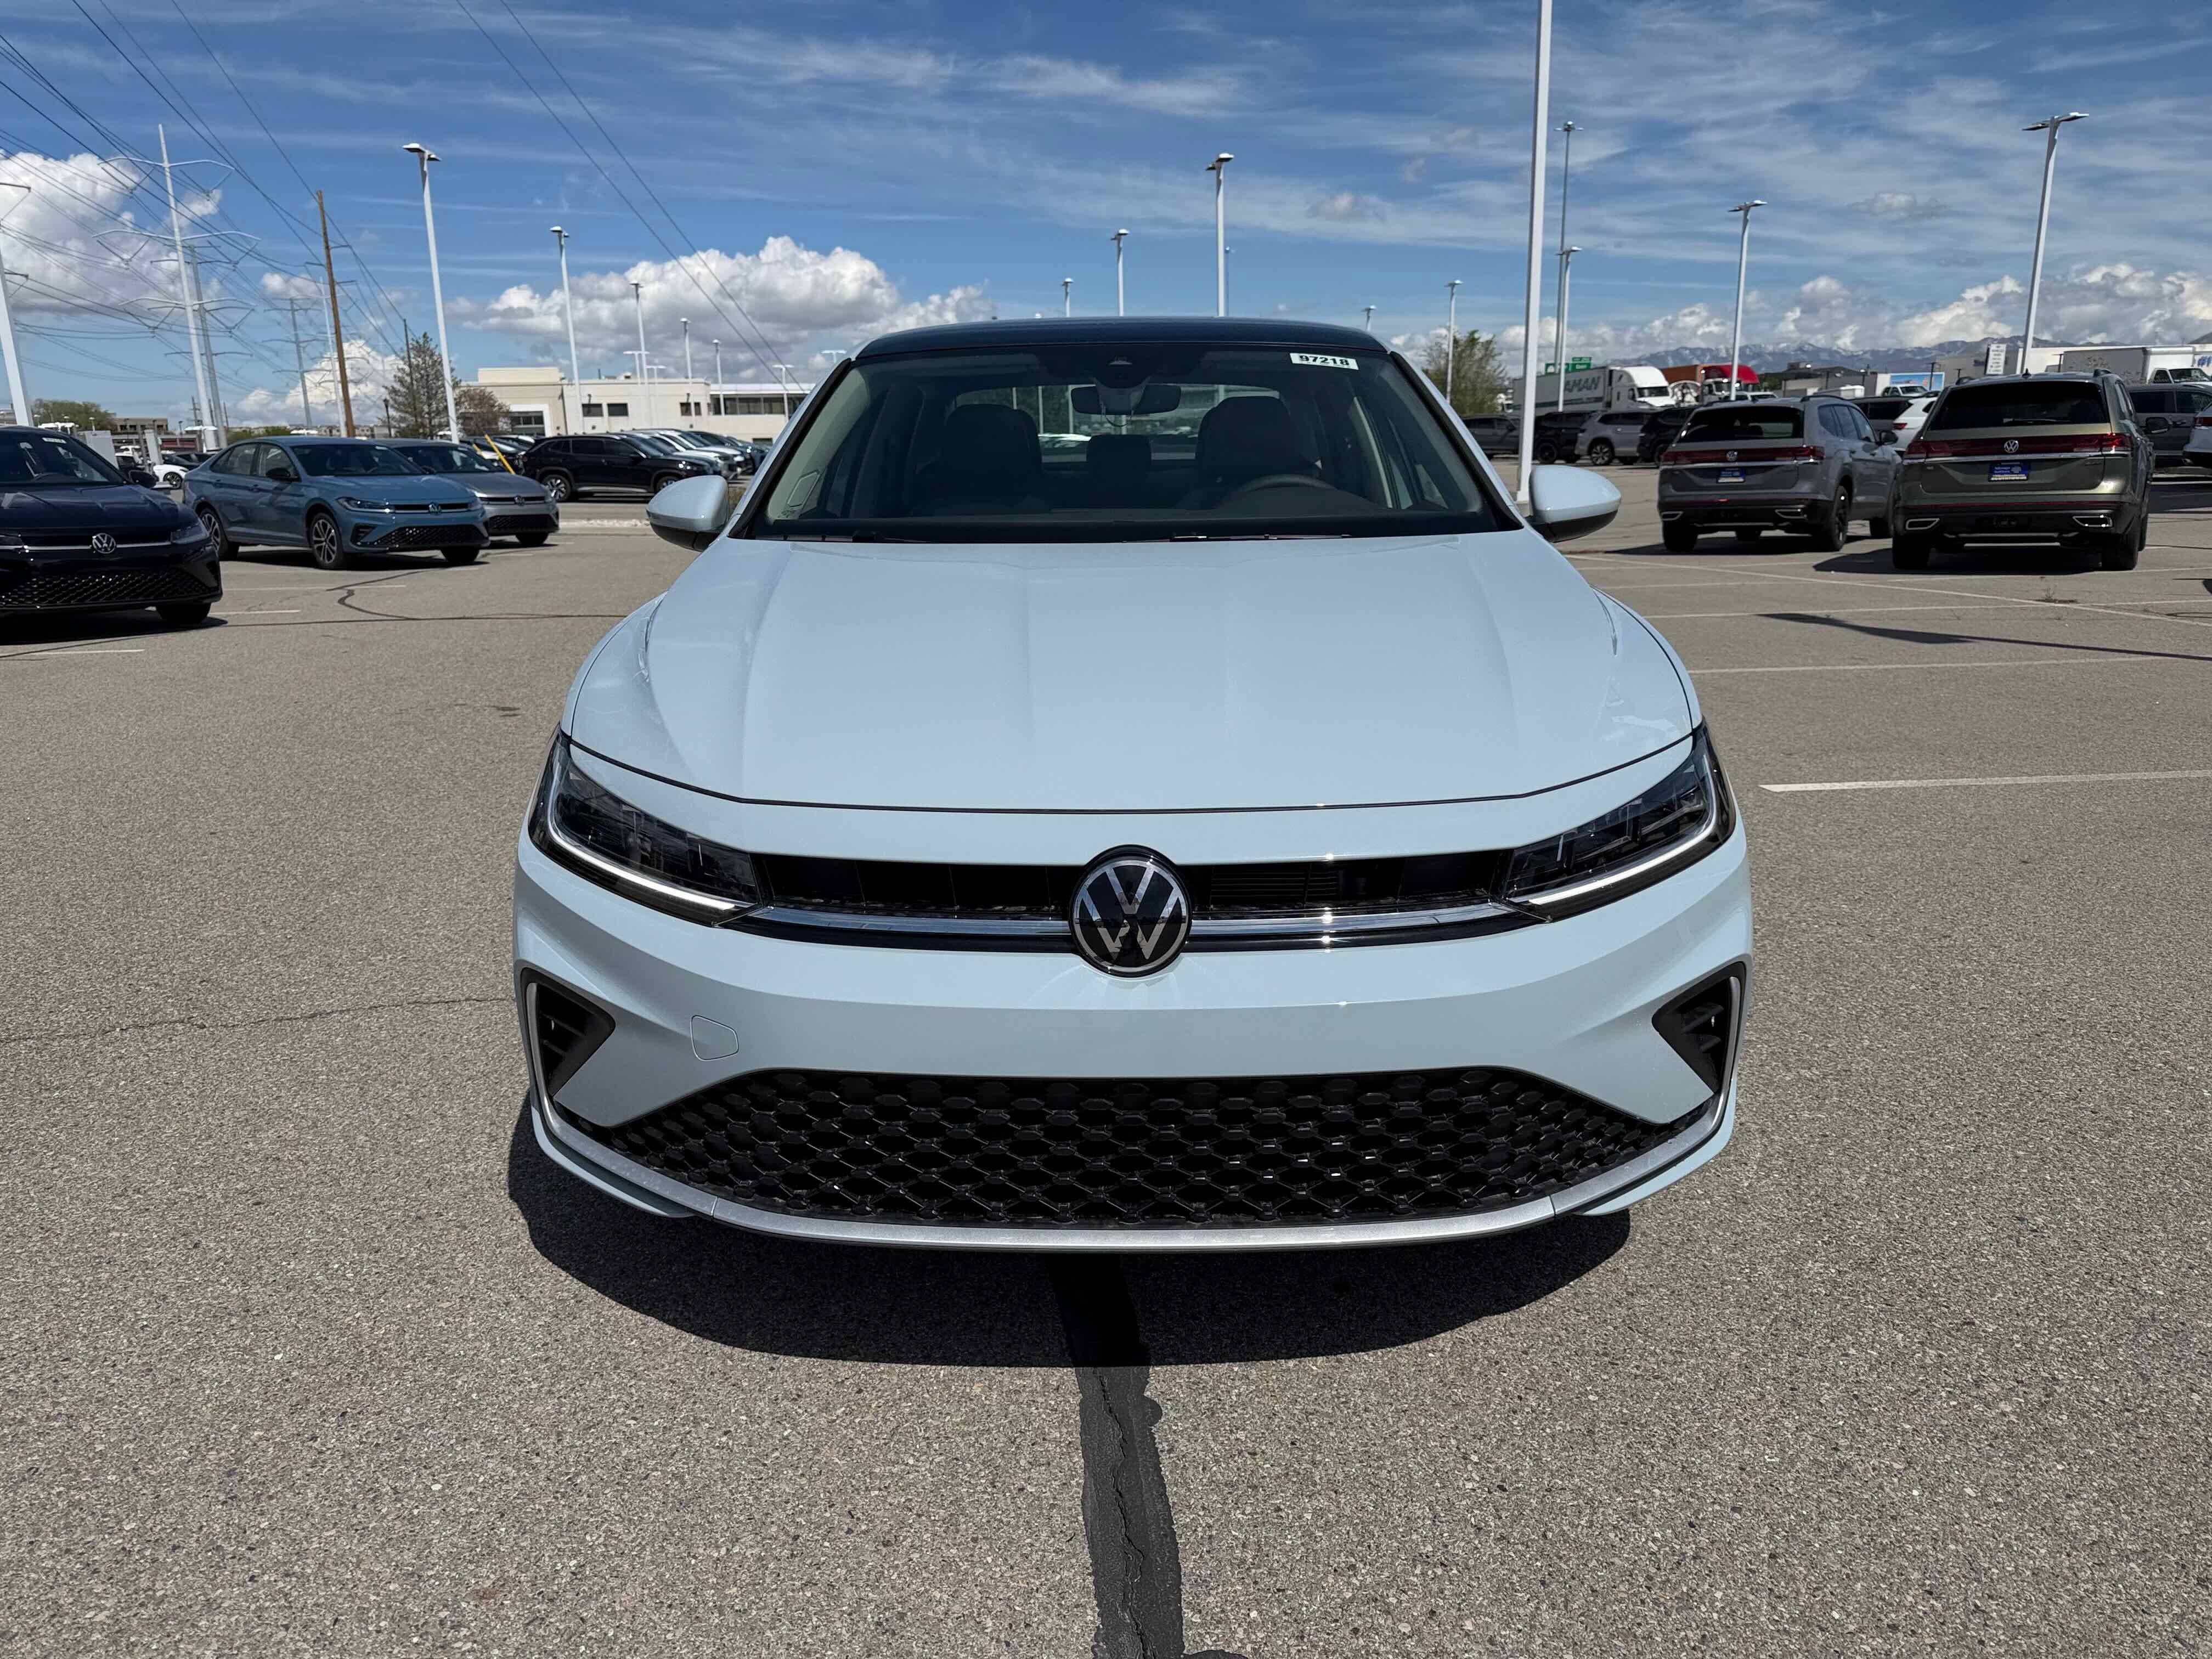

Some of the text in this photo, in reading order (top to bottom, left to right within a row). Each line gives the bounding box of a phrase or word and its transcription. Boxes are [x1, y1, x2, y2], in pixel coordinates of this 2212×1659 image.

[1299, 355, 1350, 366] 97218
[2004, 439, 2019, 453] VW
[92, 533, 116, 554] VW
[1073, 859, 1189, 973] VW
